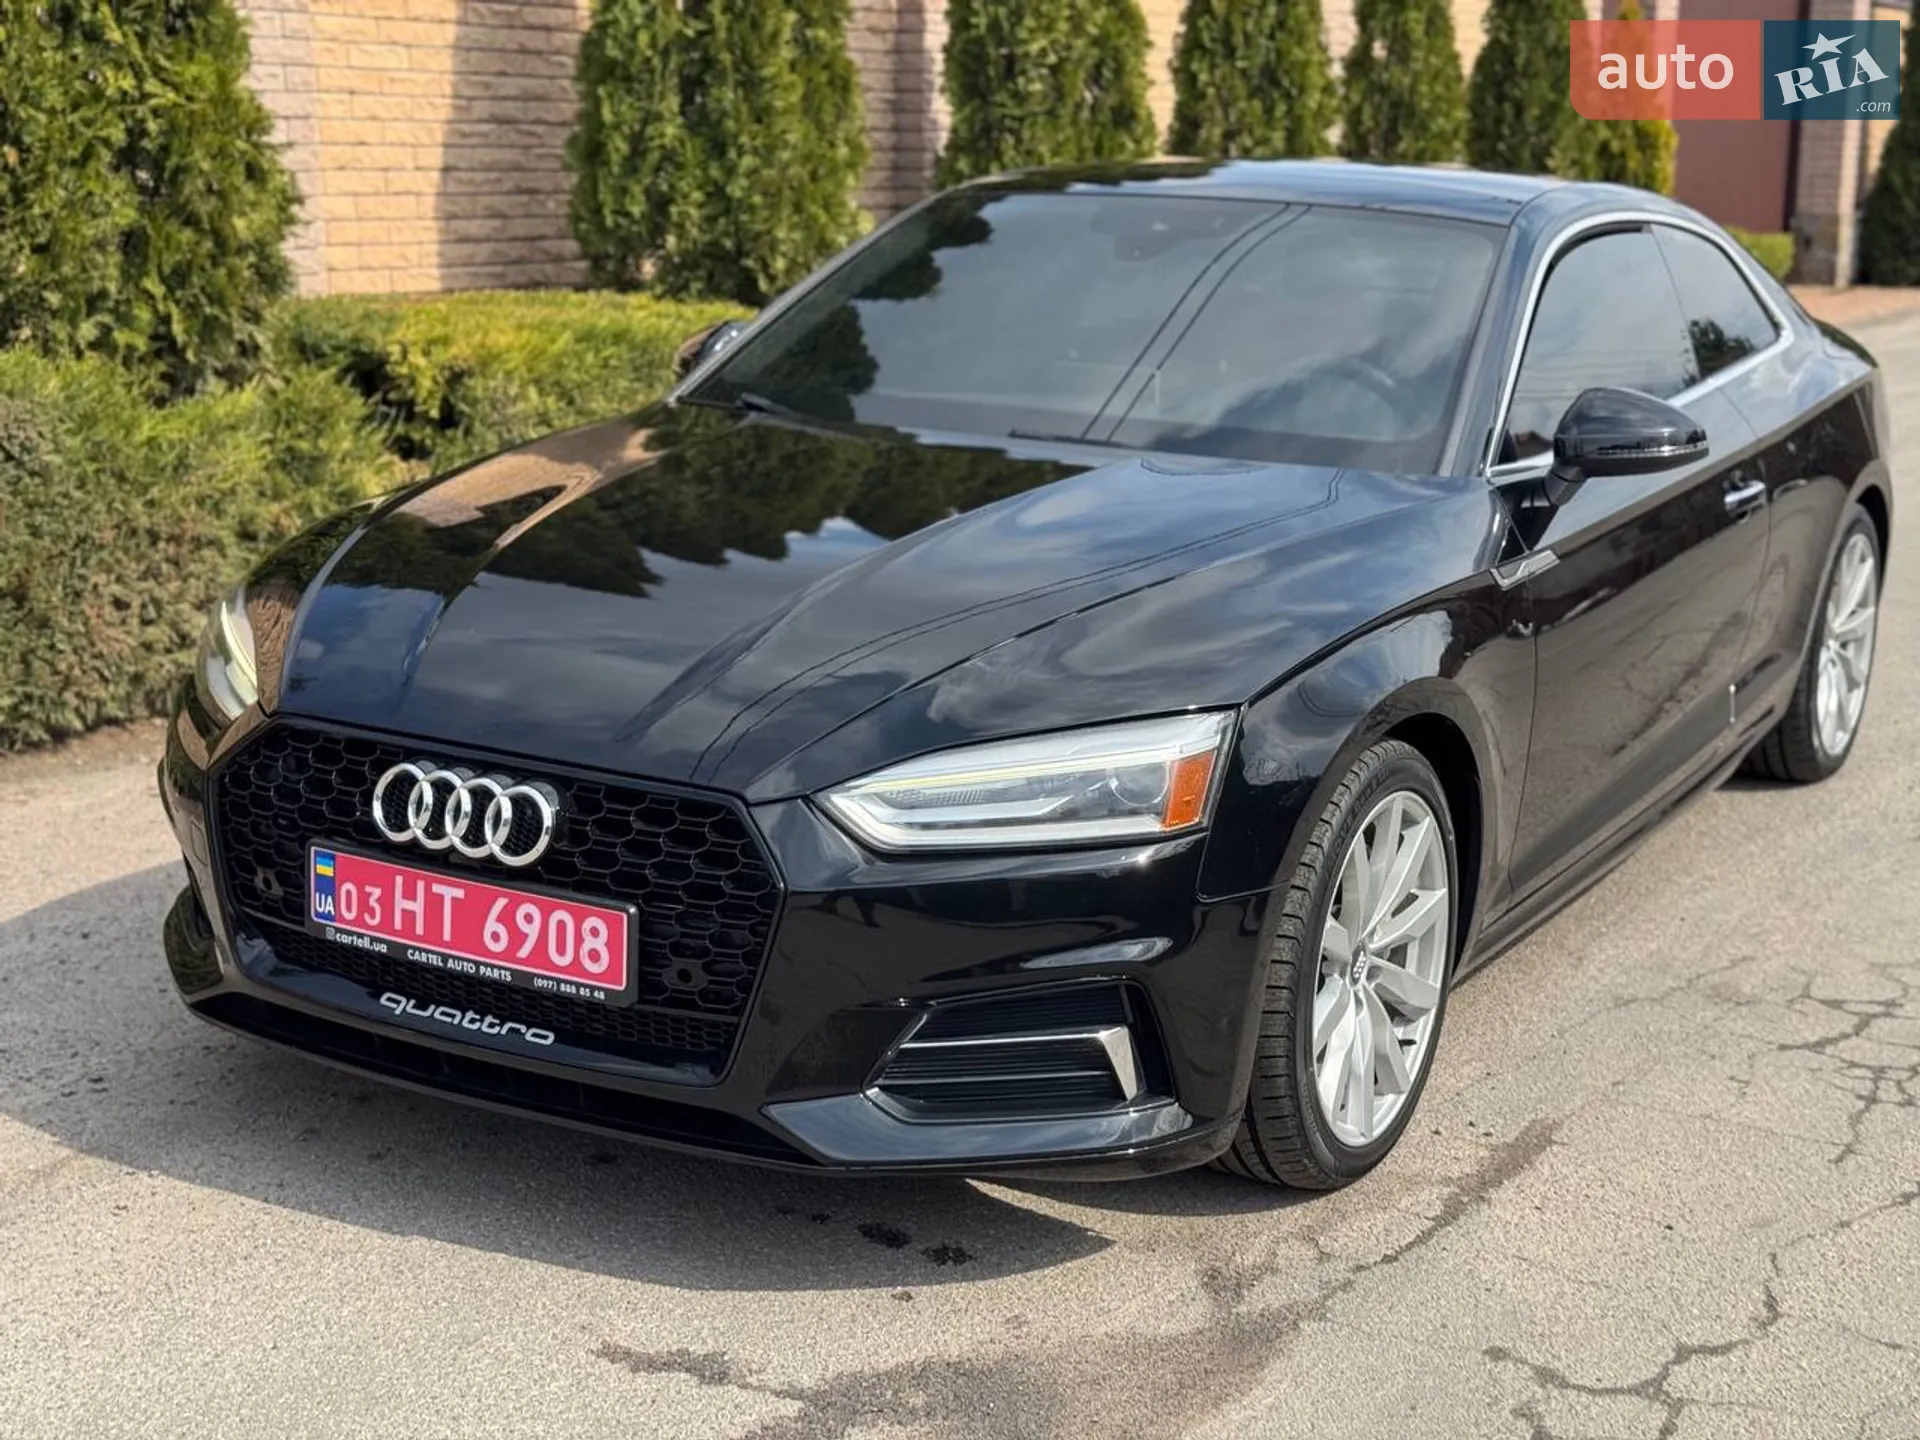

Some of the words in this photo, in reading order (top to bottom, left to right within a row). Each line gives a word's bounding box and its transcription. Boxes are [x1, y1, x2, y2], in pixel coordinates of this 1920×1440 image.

[315, 892, 335, 916] UA
[339, 882, 382, 926] 03
[393, 874, 465, 942] HT
[482, 897, 610, 974] 6908
[407, 949, 444, 967] CARTEL
[447, 958, 476, 974] AUTO
[479, 966, 512, 982] PARTS
[379, 991, 555, 1046] quattro
